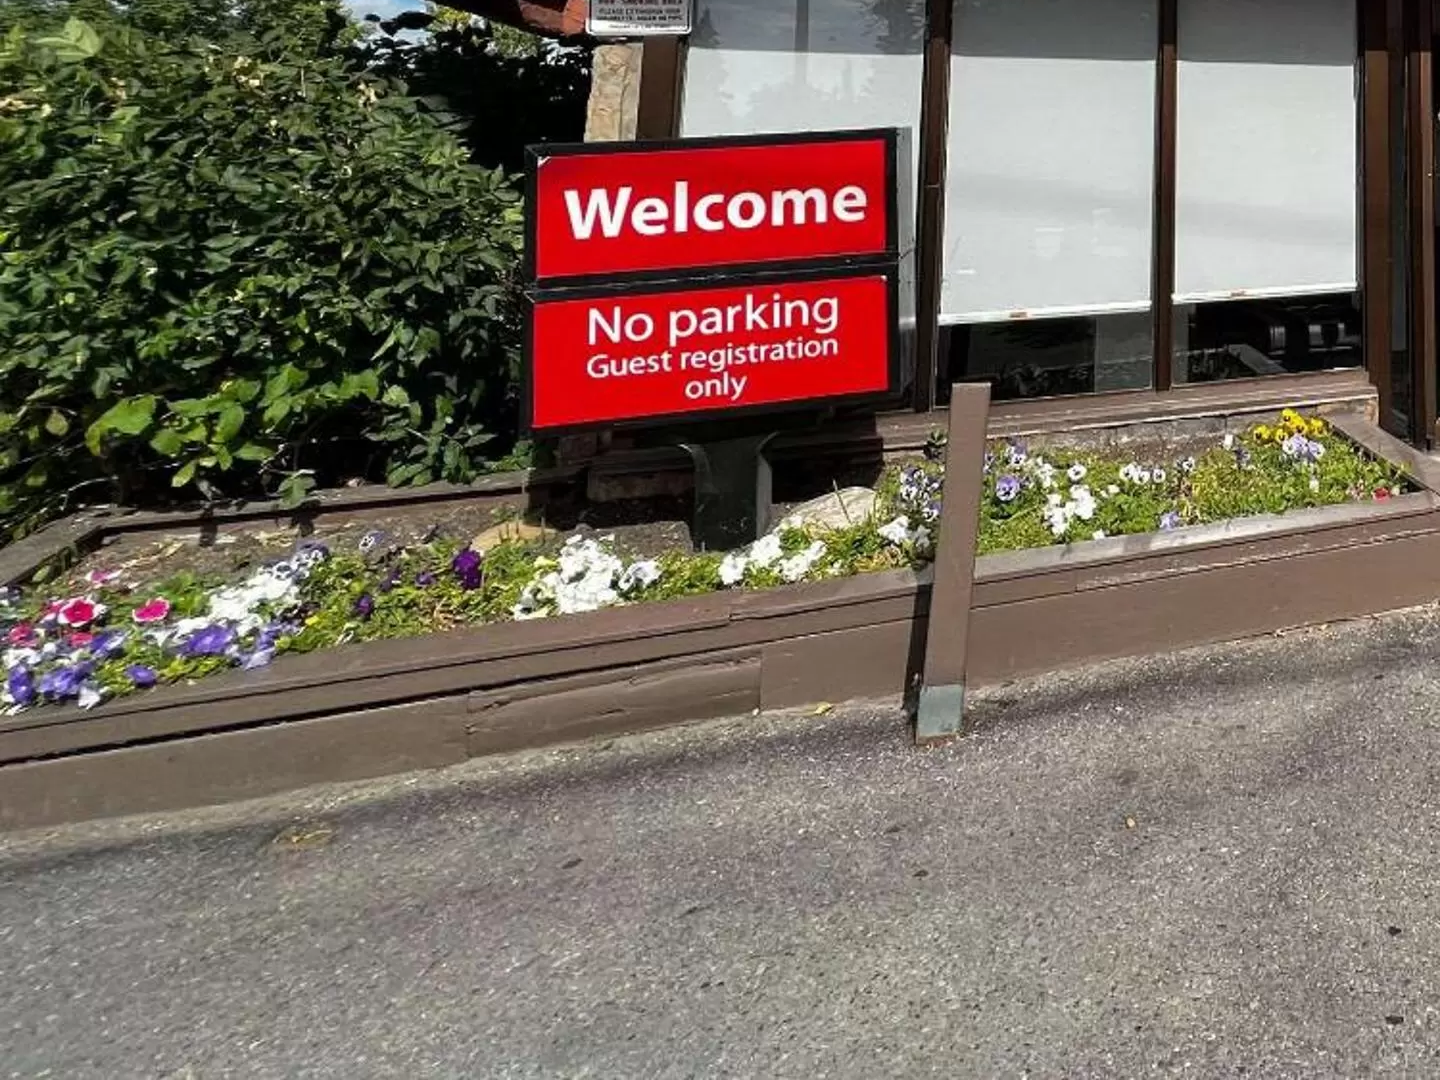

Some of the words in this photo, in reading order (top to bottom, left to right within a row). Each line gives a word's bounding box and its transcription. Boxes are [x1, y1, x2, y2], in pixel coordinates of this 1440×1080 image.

[563, 181, 867, 240] Welcome
[587, 306, 655, 346] No
[669, 293, 839, 347] parking
[586, 353, 673, 379] Guest
[680, 335, 839, 373] registration
[684, 371, 748, 401] only
